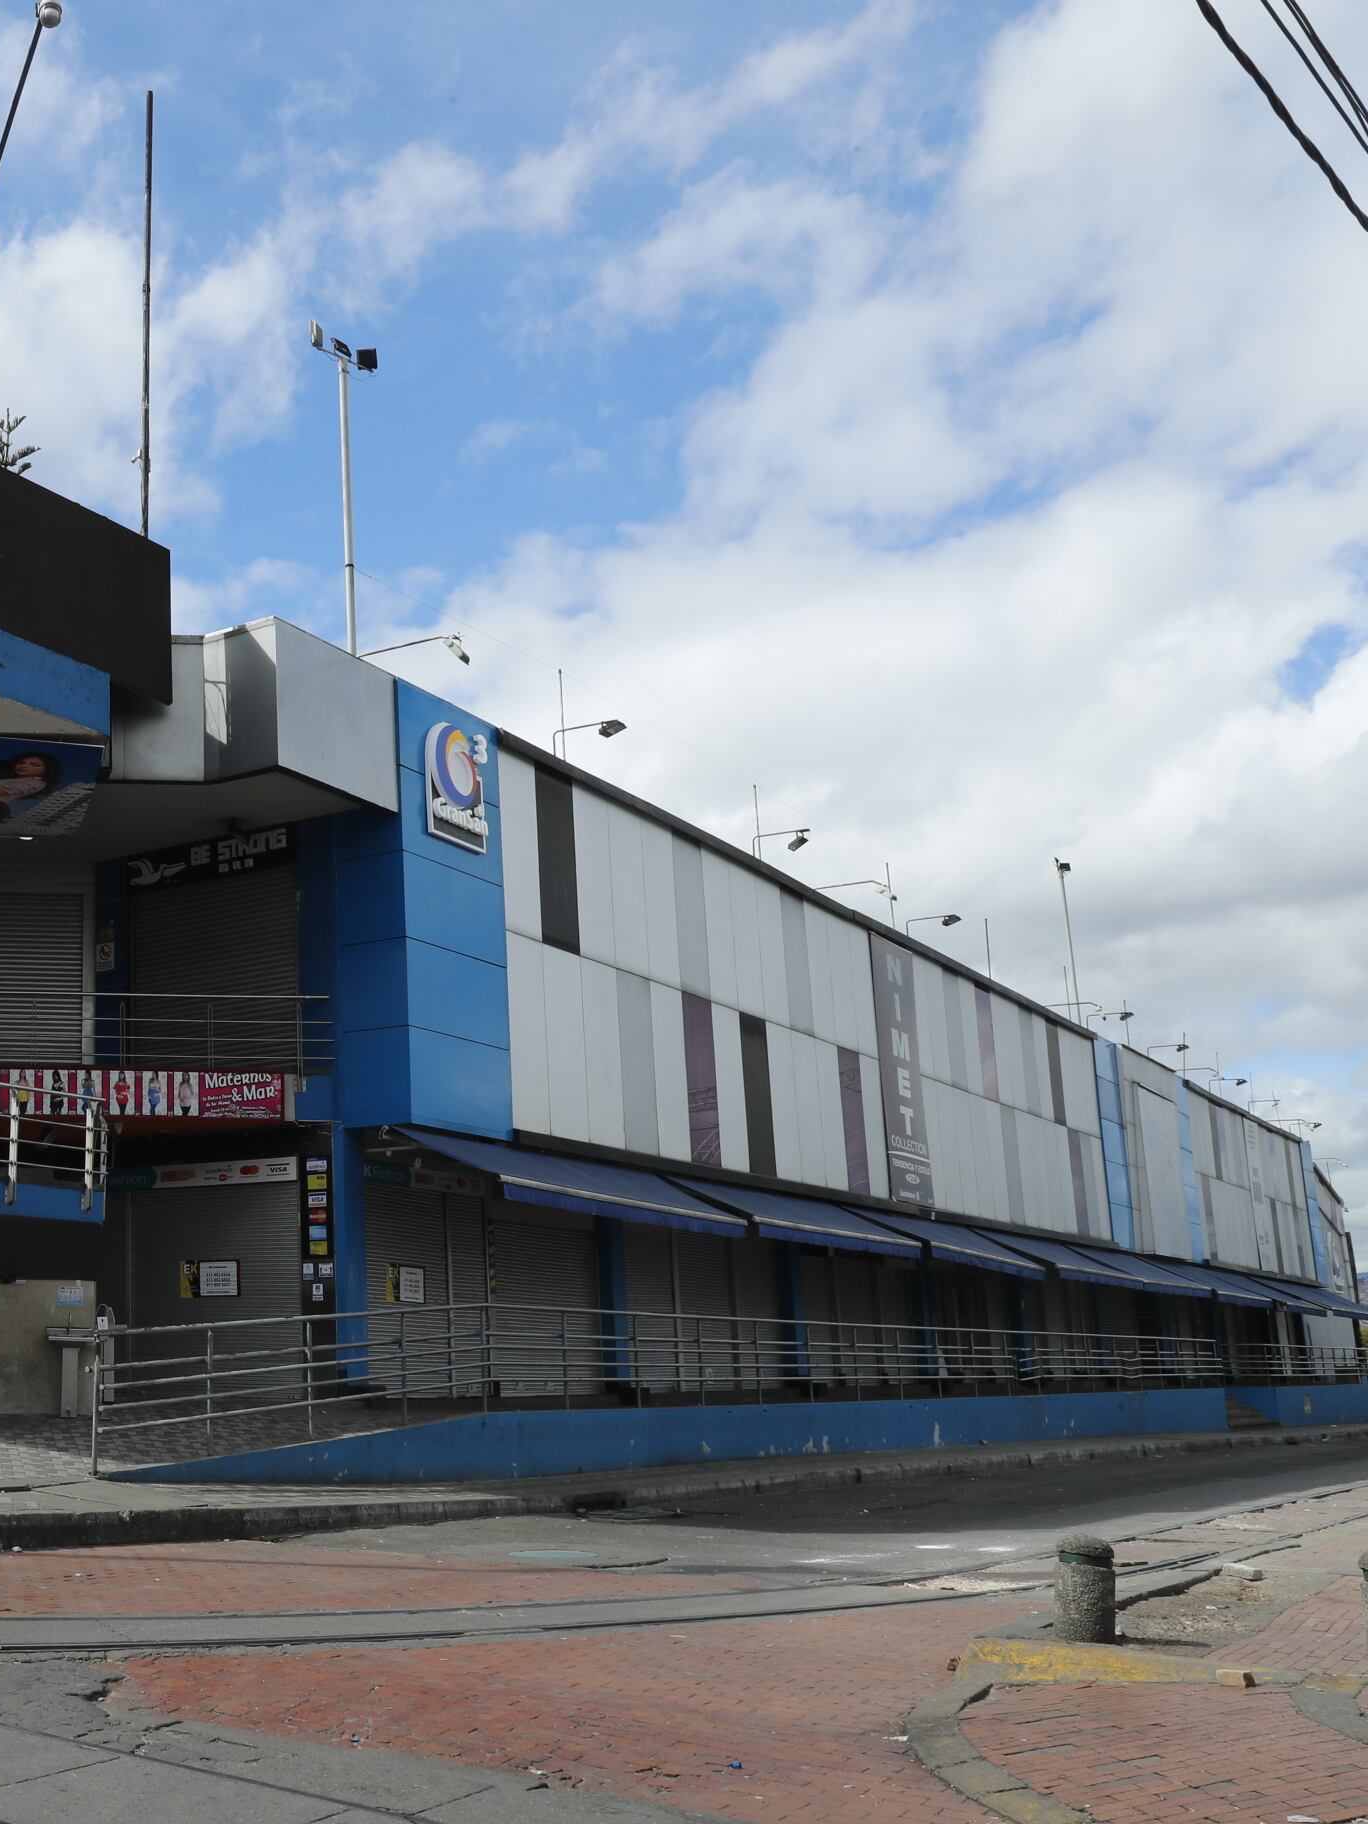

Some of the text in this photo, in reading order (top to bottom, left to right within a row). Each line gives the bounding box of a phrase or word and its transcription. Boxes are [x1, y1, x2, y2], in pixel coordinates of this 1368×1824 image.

[472, 734, 488, 765] 3
[432, 797, 489, 837] GranSan
[189, 844, 212, 866] BE
[216, 828, 288, 861] STRONG
[885, 953, 915, 1137] NIMET
[231, 1085, 276, 1102] & Mar
[891, 1134, 928, 1156] COLLECTION
[183, 1263, 198, 1275] EK
